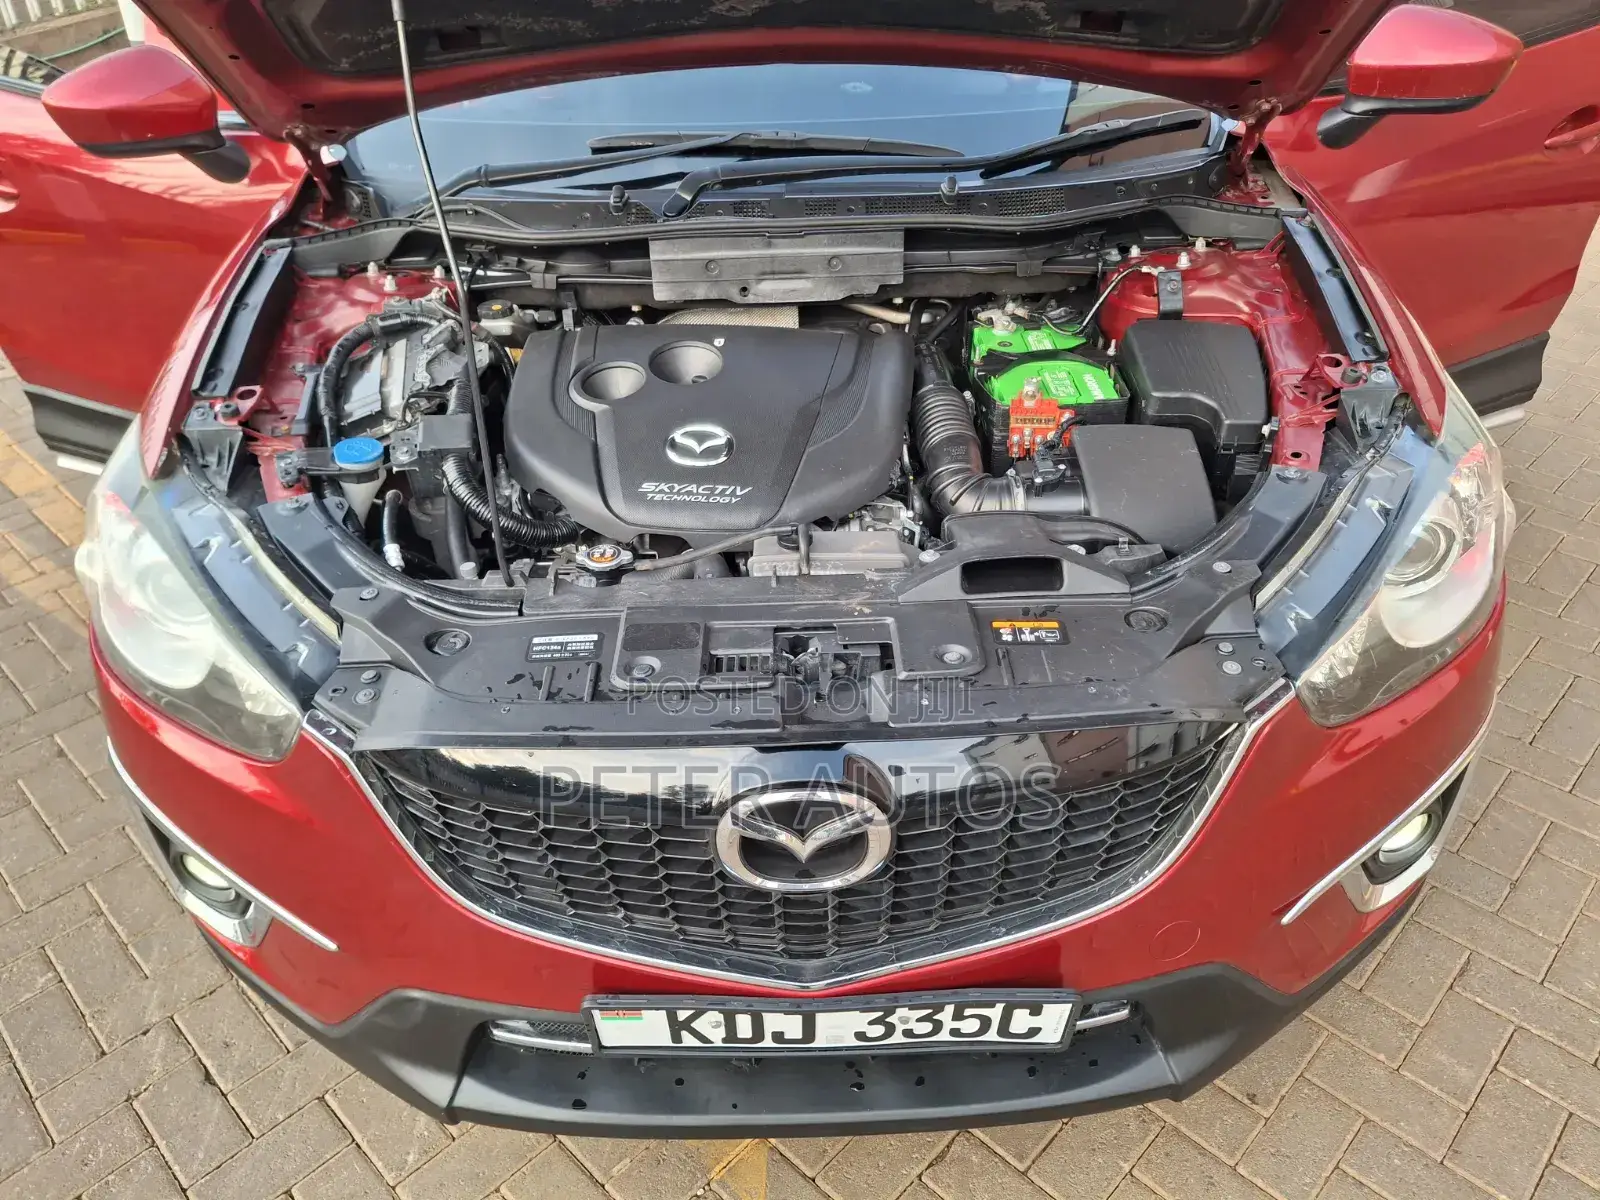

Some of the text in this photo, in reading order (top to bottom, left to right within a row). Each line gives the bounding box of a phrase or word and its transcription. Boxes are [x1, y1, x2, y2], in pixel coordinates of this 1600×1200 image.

[638, 482, 753, 496] SKYACTIV
[646, 493, 741, 504] TECHNOLOGY
[666, 1008, 817, 1046] KDJ
[853, 1003, 1045, 1043] 335C
